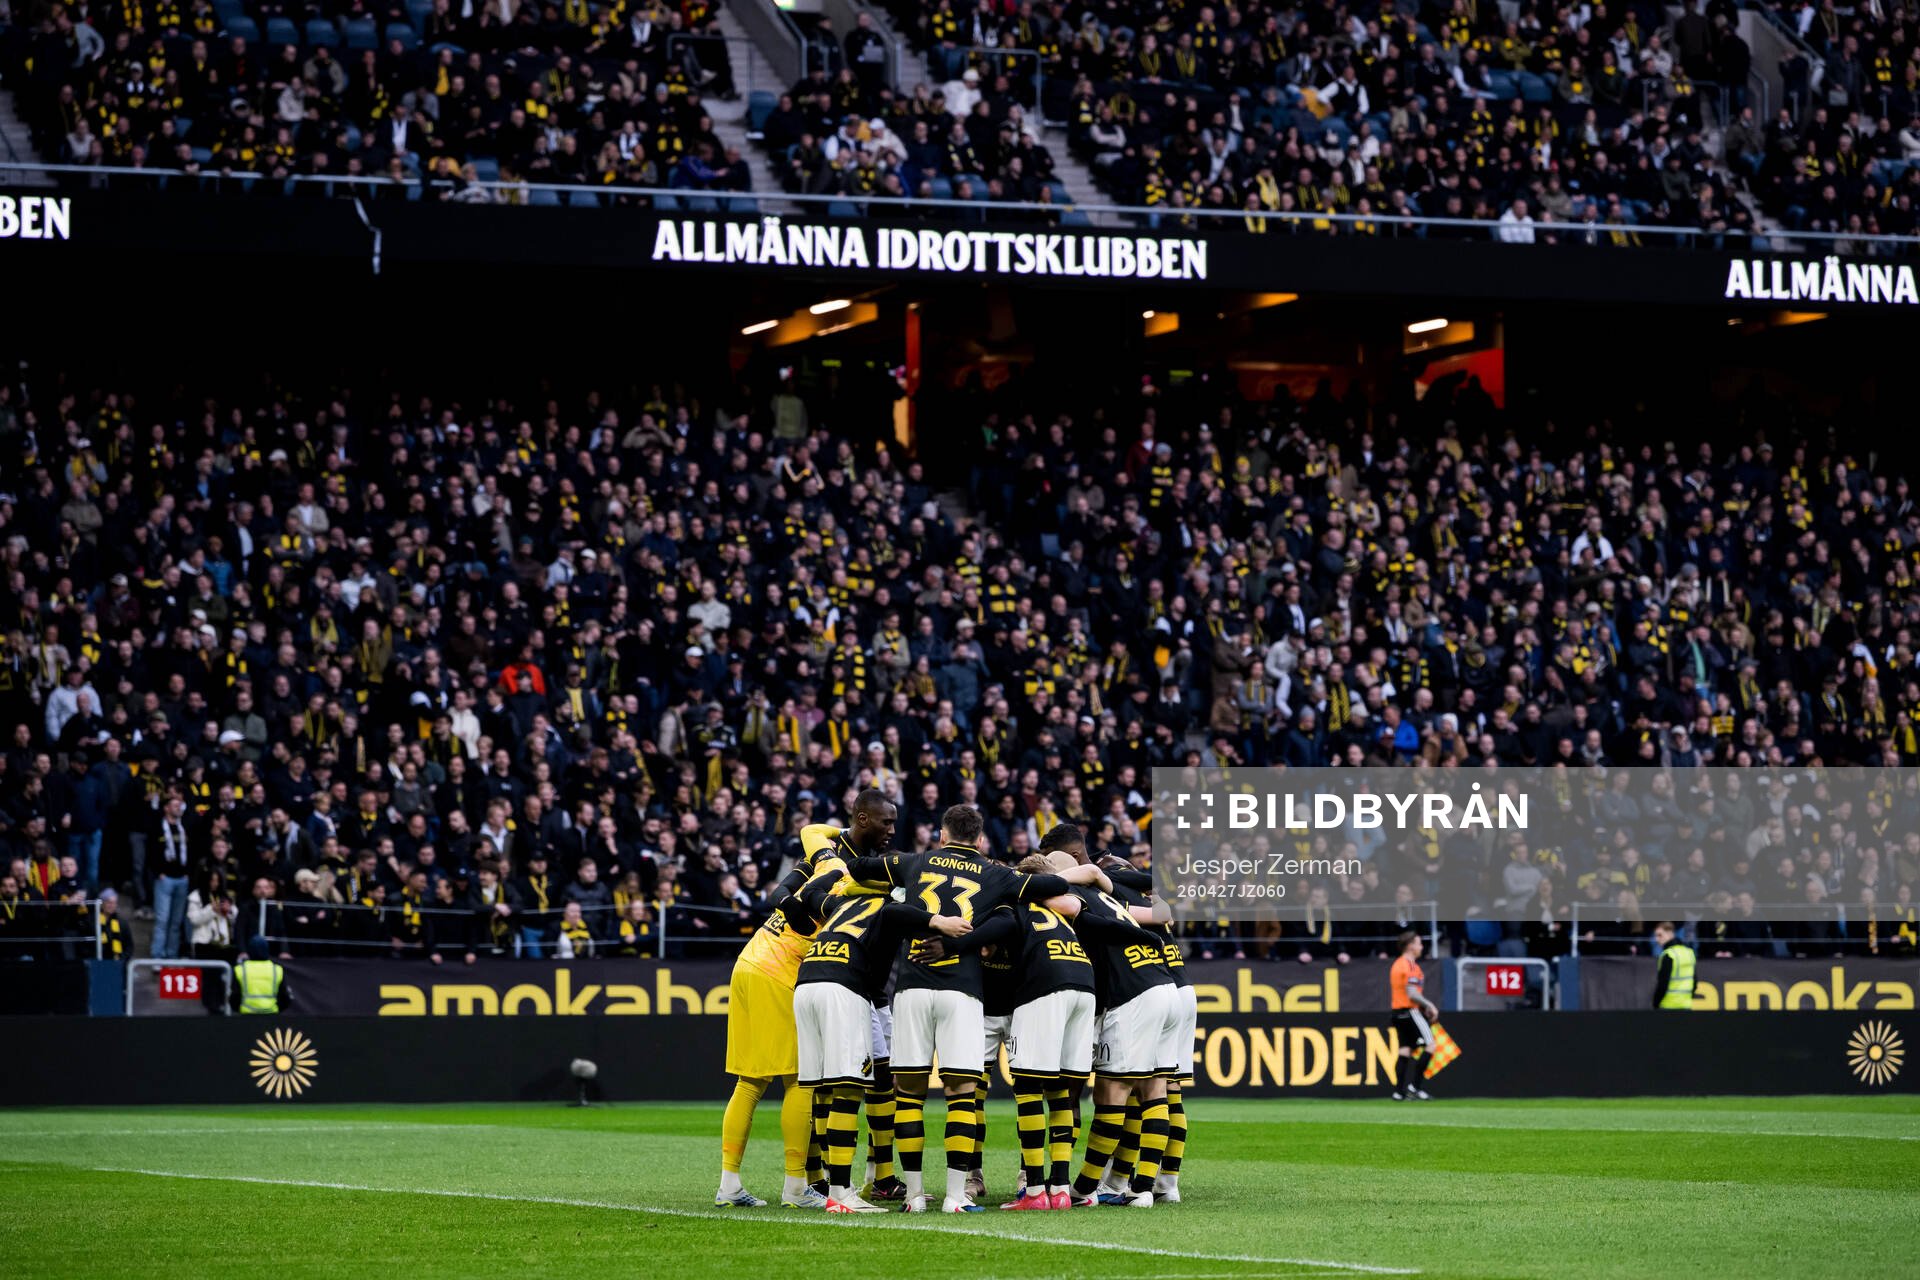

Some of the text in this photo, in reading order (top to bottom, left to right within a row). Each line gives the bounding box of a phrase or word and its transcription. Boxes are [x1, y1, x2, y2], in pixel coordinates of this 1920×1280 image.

[0, 195, 71, 240] BEN
[652, 217, 1208, 279] ALLMÄNNA IDROTTSKLUBBEN
[1725, 255, 1920, 304] ALLMÄNNA
[928, 856, 983, 874] CSONGVAI
[918, 871, 982, 925] 33
[818, 896, 885, 938] 12
[805, 941, 850, 959] SVEA
[1046, 939, 1087, 958] SVE
[162, 974, 199, 993] 113
[1488, 971, 1521, 990] 112
